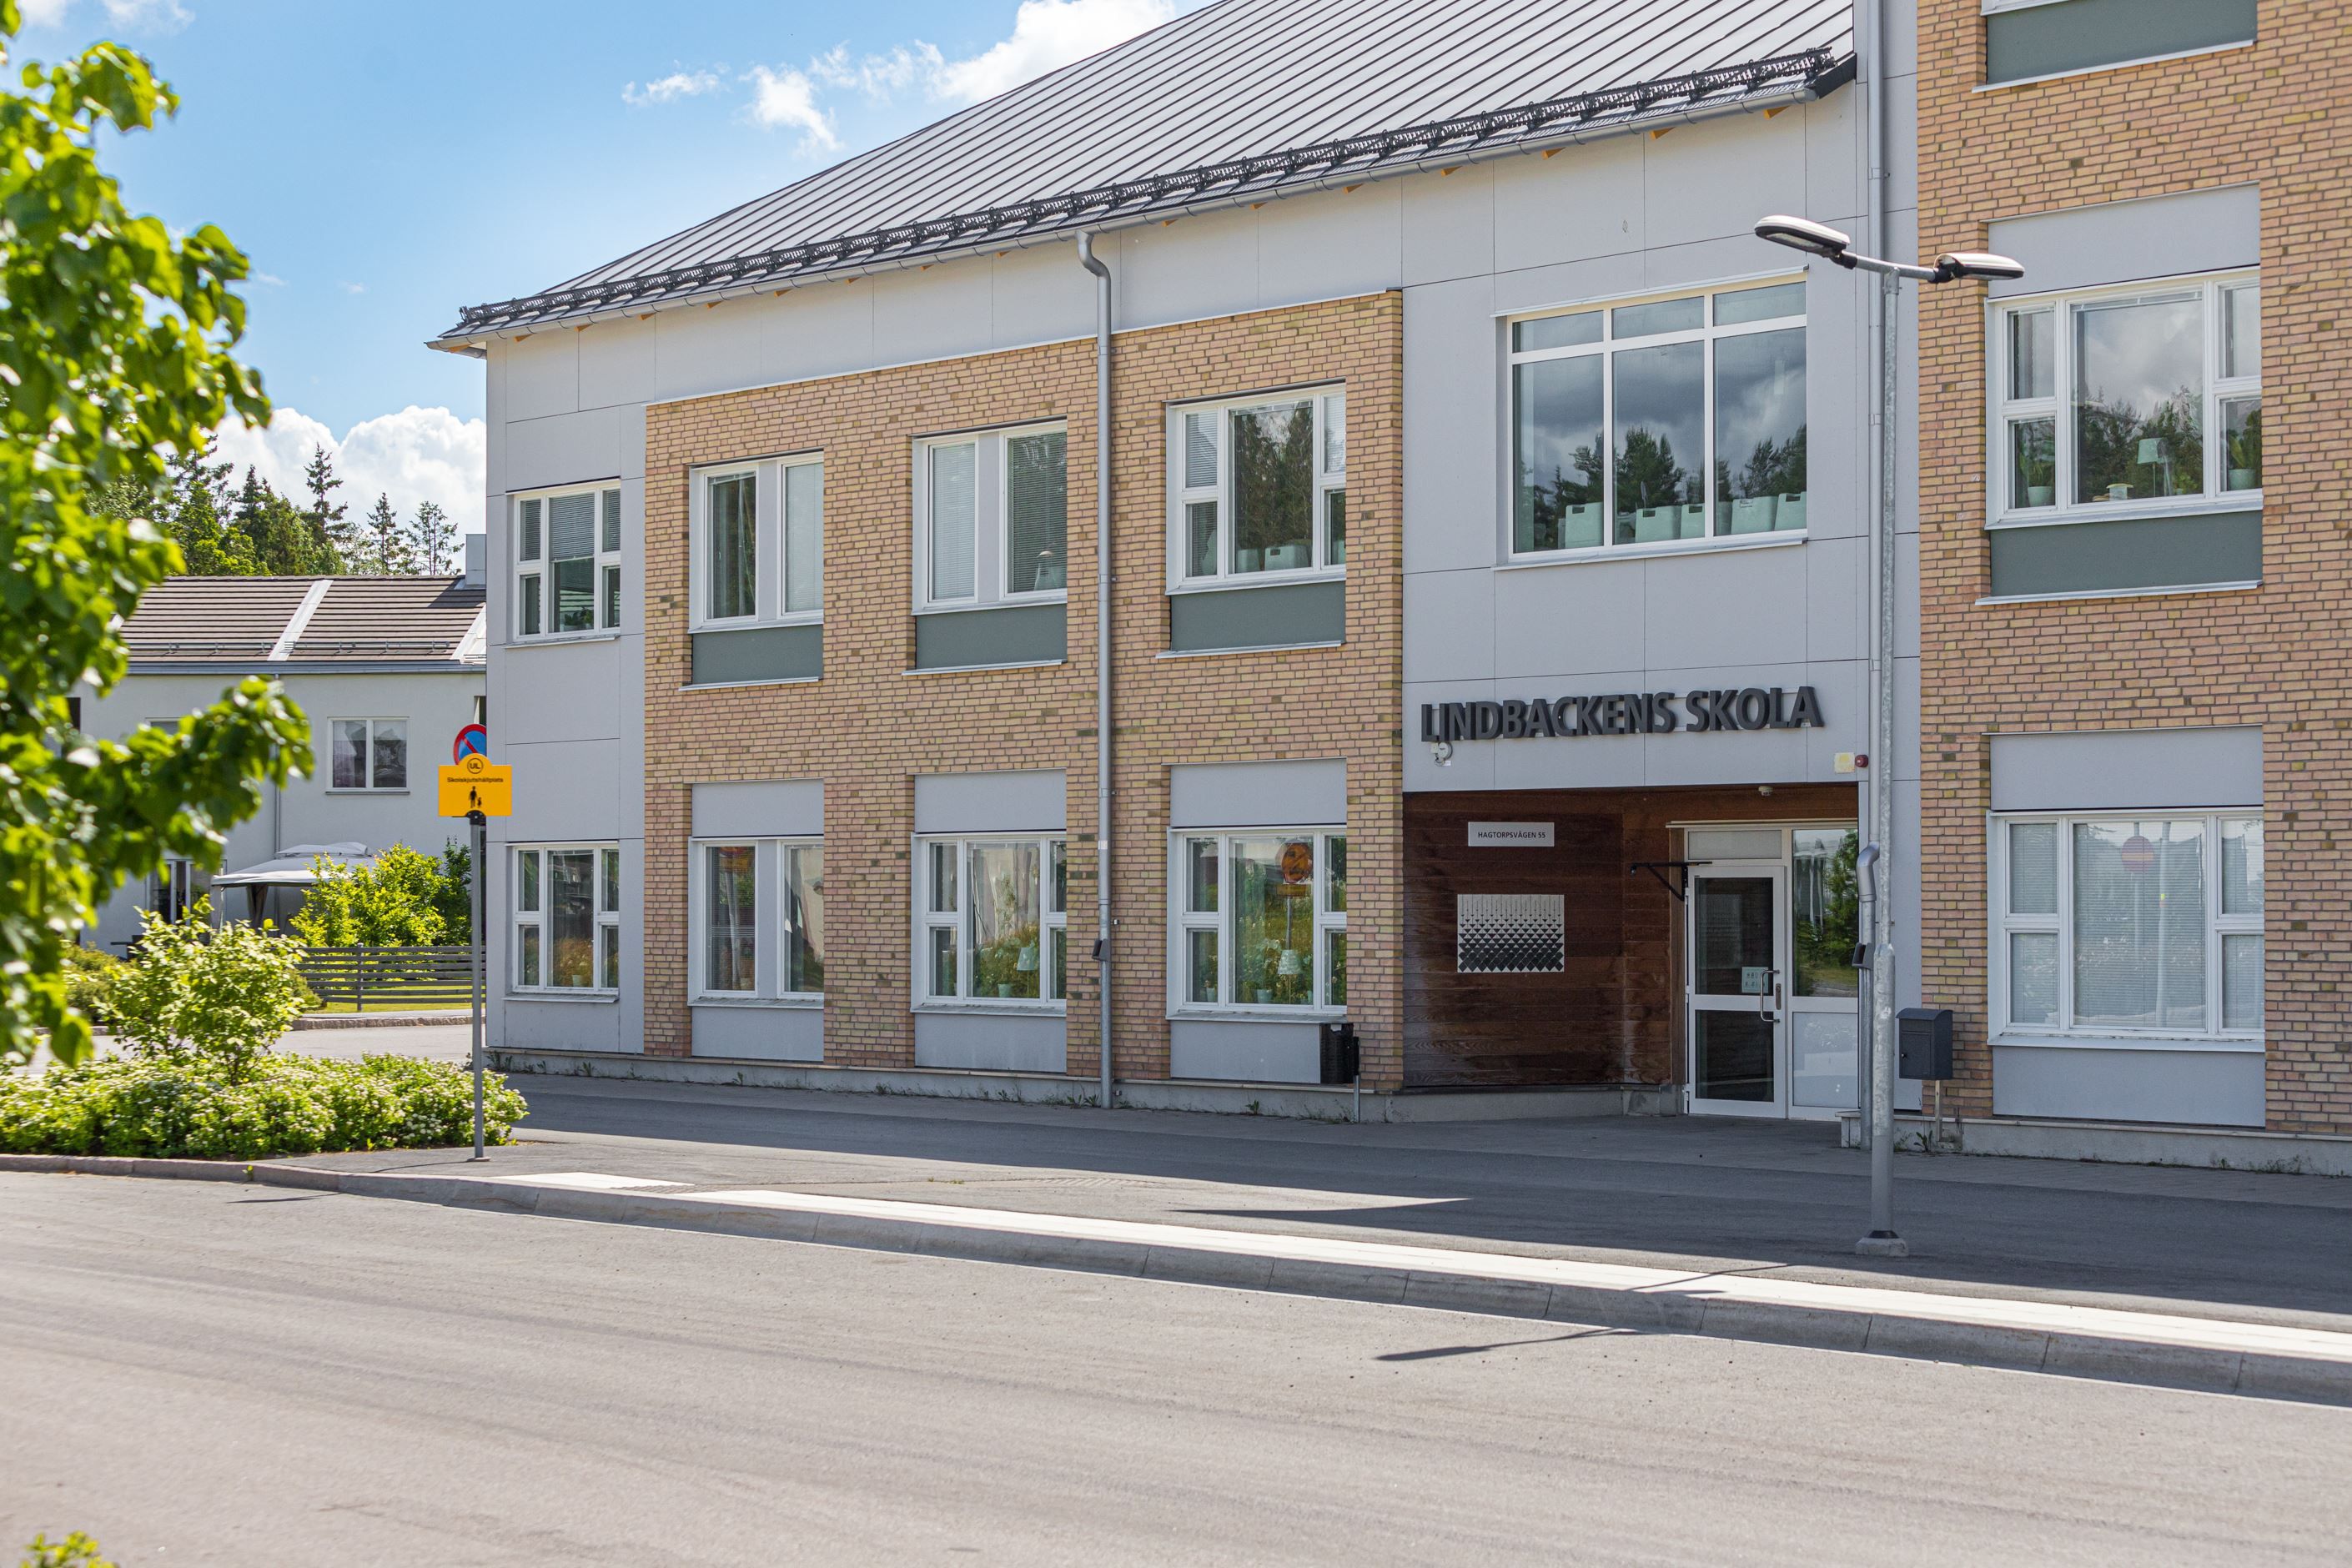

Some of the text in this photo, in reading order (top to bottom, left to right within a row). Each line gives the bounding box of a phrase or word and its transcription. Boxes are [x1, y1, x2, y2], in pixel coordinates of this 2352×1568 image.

[1420, 686, 1825, 742] LINDBACKENS SKOLA
[1477, 831, 1536, 839] HAGTORPSVÄGEN
